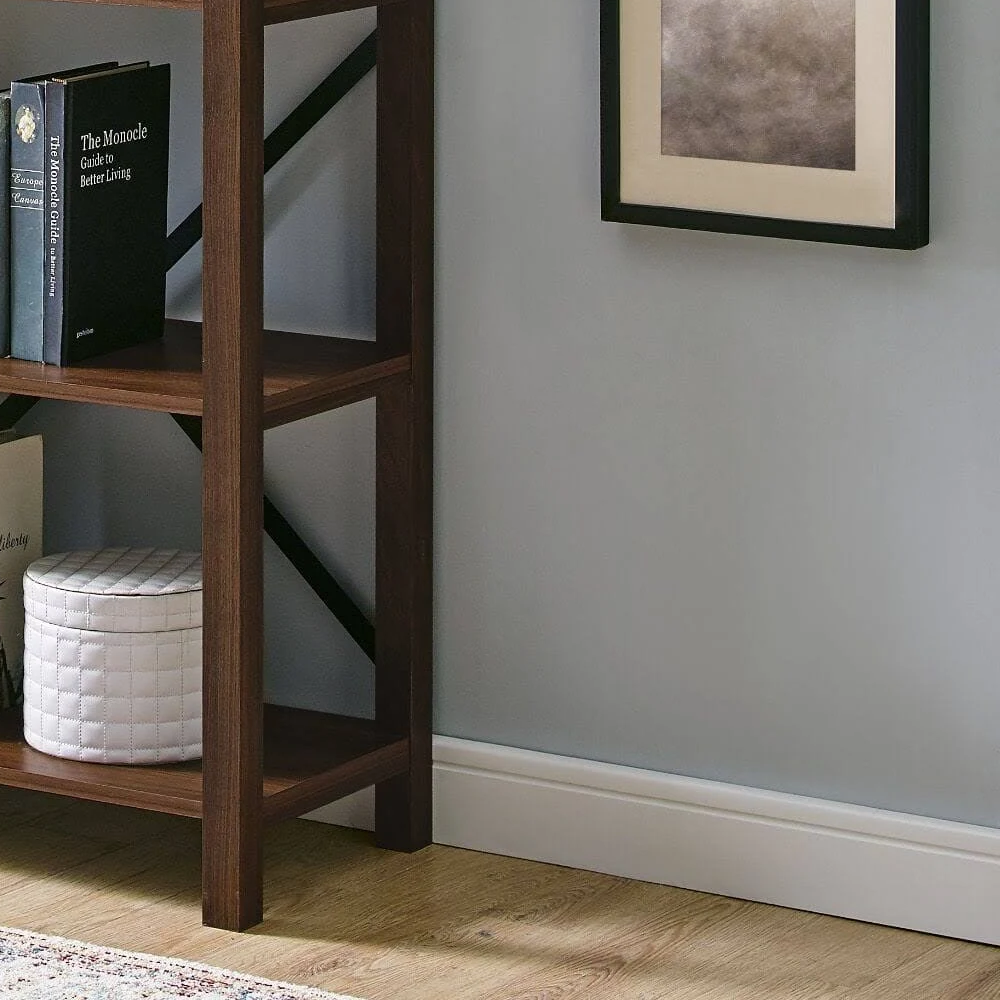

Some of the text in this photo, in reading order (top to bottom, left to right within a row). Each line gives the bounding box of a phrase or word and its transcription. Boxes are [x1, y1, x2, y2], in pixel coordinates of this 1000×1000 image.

[50, 135, 60, 157] The
[80, 122, 148, 152] The Monocle
[80, 153, 114, 170] Guide to
[12, 173, 43, 188] Europe
[50, 158, 60, 208] Monocle
[80, 166, 132, 187] Better Living
[12, 192, 43, 205] Canvas
[50, 210, 60, 244] Guide
